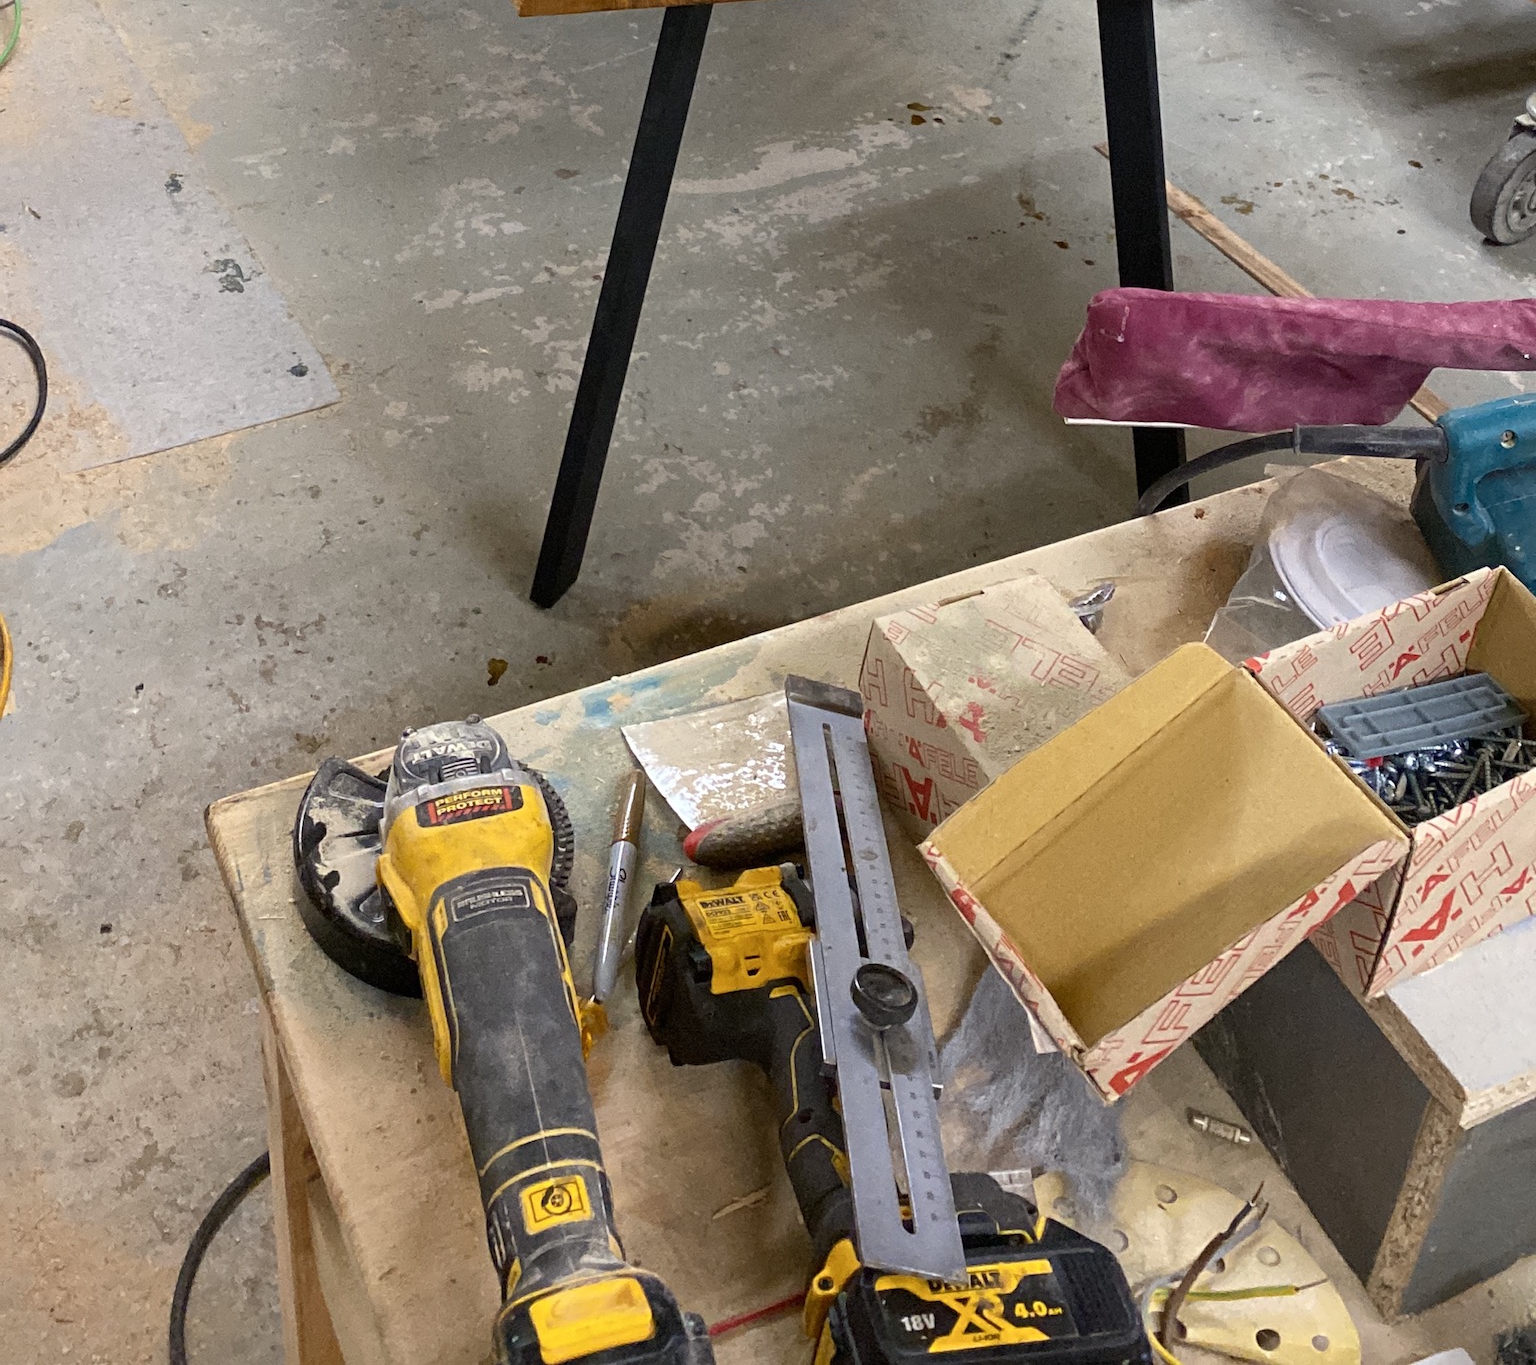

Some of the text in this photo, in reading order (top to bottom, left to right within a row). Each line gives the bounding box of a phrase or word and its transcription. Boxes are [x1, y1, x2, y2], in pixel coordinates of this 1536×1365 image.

[434, 787, 503, 807] PERFORM
[436, 796, 503, 816] PROTECT
[457, 889, 524, 909] BRUSHLESS
[469, 896, 514, 910] MOTOR
[901, 1313, 936, 1332] 18V
